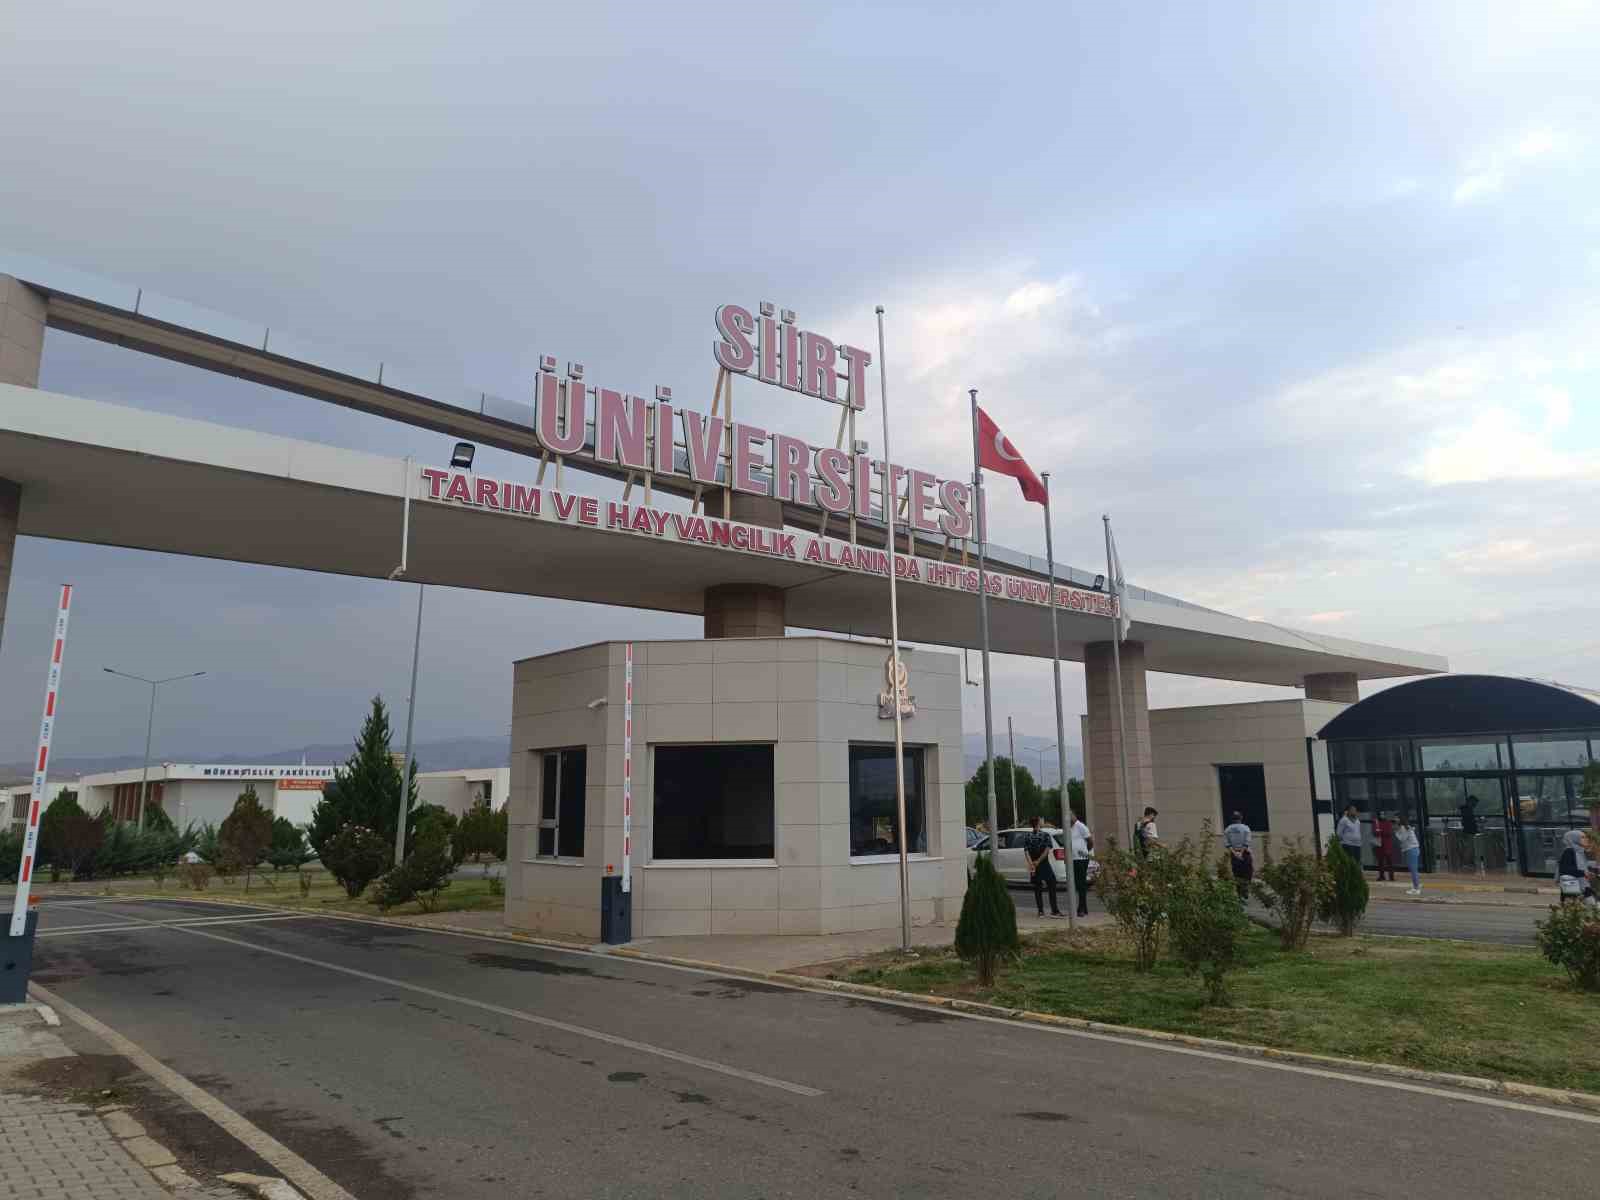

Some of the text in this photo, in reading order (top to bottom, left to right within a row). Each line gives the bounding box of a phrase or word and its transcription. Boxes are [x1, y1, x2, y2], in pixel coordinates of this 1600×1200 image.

[713, 300, 872, 411] SİİRT
[535, 353, 988, 544] ÜNİVERSİTESİ
[423, 468, 542, 515] TARIM
[551, 490, 599, 525] VE
[606, 501, 796, 558] HAYVANCILIK
[804, 537, 921, 582] ALANINDA
